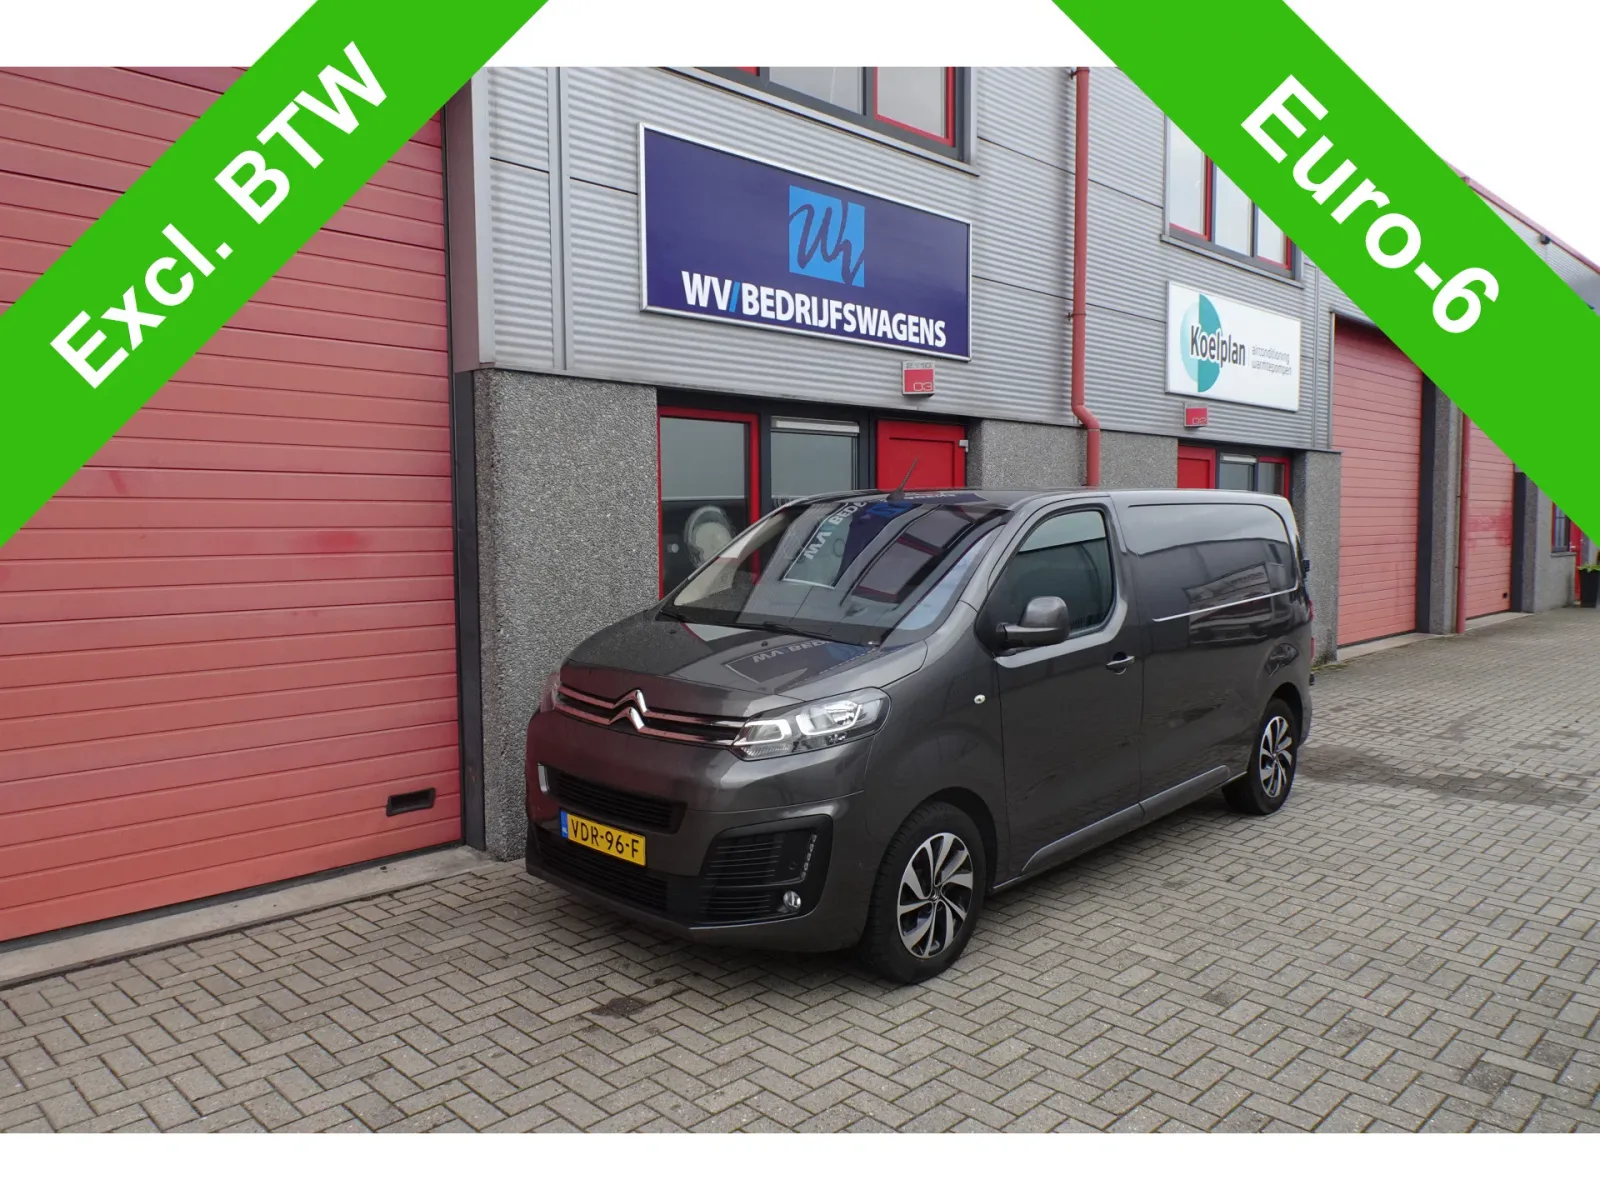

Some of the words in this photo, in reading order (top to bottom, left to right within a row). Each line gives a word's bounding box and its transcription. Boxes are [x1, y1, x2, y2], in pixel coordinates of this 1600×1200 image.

[1190, 325, 1245, 367] Koelplan
[1252, 345, 1290, 364] airconditioning
[571, 818, 640, 858] VDR-96-F
